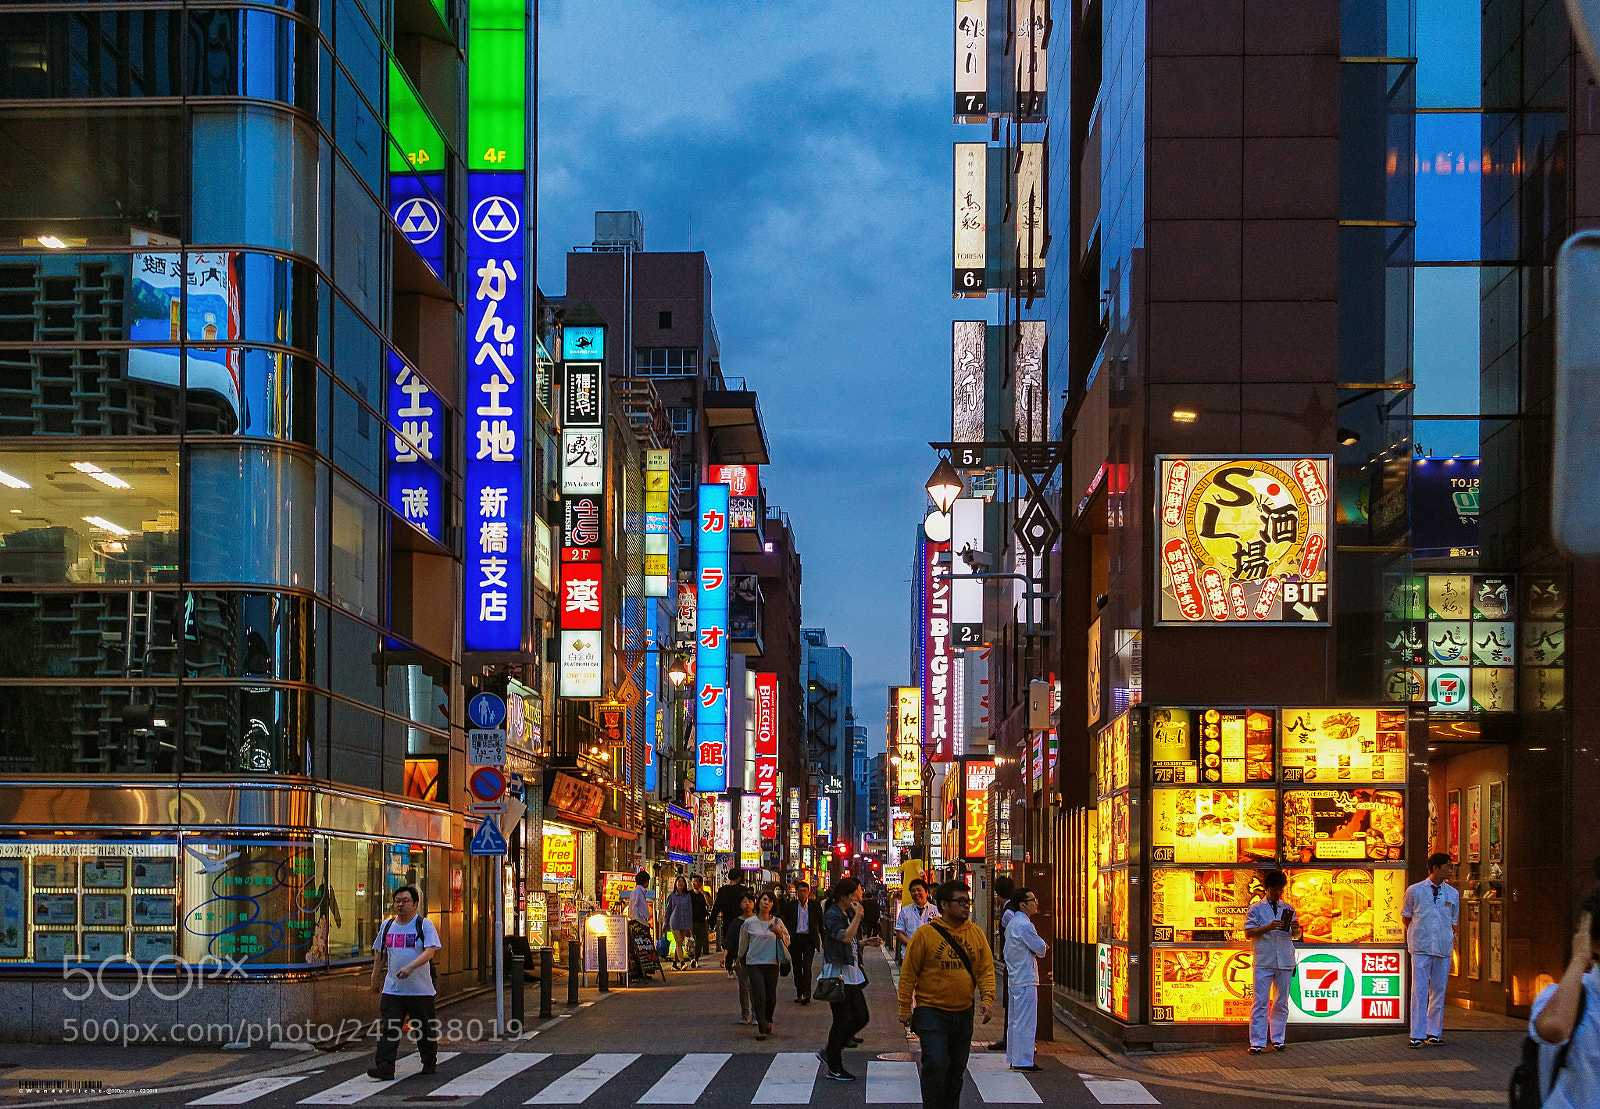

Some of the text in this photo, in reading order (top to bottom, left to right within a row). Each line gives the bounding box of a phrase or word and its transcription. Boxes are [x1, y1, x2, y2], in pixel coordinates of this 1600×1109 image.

[966, 96, 984, 111] 7F
[483, 148, 506, 163] 4F
[963, 271, 983, 287] 6F
[474, 259, 517, 622] かんべ土地 新橋支店
[962, 449, 982, 465] 5F
[1260, 463, 1296, 492] IZAKAYA
[1186, 478, 1211, 525] SHINBASHI
[564, 500, 572, 547] BRITISH PUB
[572, 498, 599, 546] HUB
[1186, 529, 1206, 560] TOKYO
[571, 549, 591, 561] 2F
[1302, 536, 1321, 577] ハイボール
[565, 578, 600, 613] 薬
[1283, 583, 1327, 603] B1F
[698, 509, 725, 766] カラオケ館
[960, 626, 980, 642] 2F
[758, 685, 771, 742] BIG ECHO
[758, 763, 775, 831] カラオケ
[894, 796, 906, 805] 3F
[966, 797, 984, 854] オープン
[547, 836, 572, 848] Tax-
[547, 849, 571, 860] free
[1154, 847, 1174, 861] 6F
[545, 862, 573, 874] Shop
[530, 921, 544, 931] 2F
[1154, 927, 1173, 941] 5F
[1363, 954, 1398, 972] たばこ
[1372, 978, 1390, 994] 酒
[1152, 1007, 1174, 1020] B1
[1369, 1000, 1392, 1017] ATM
